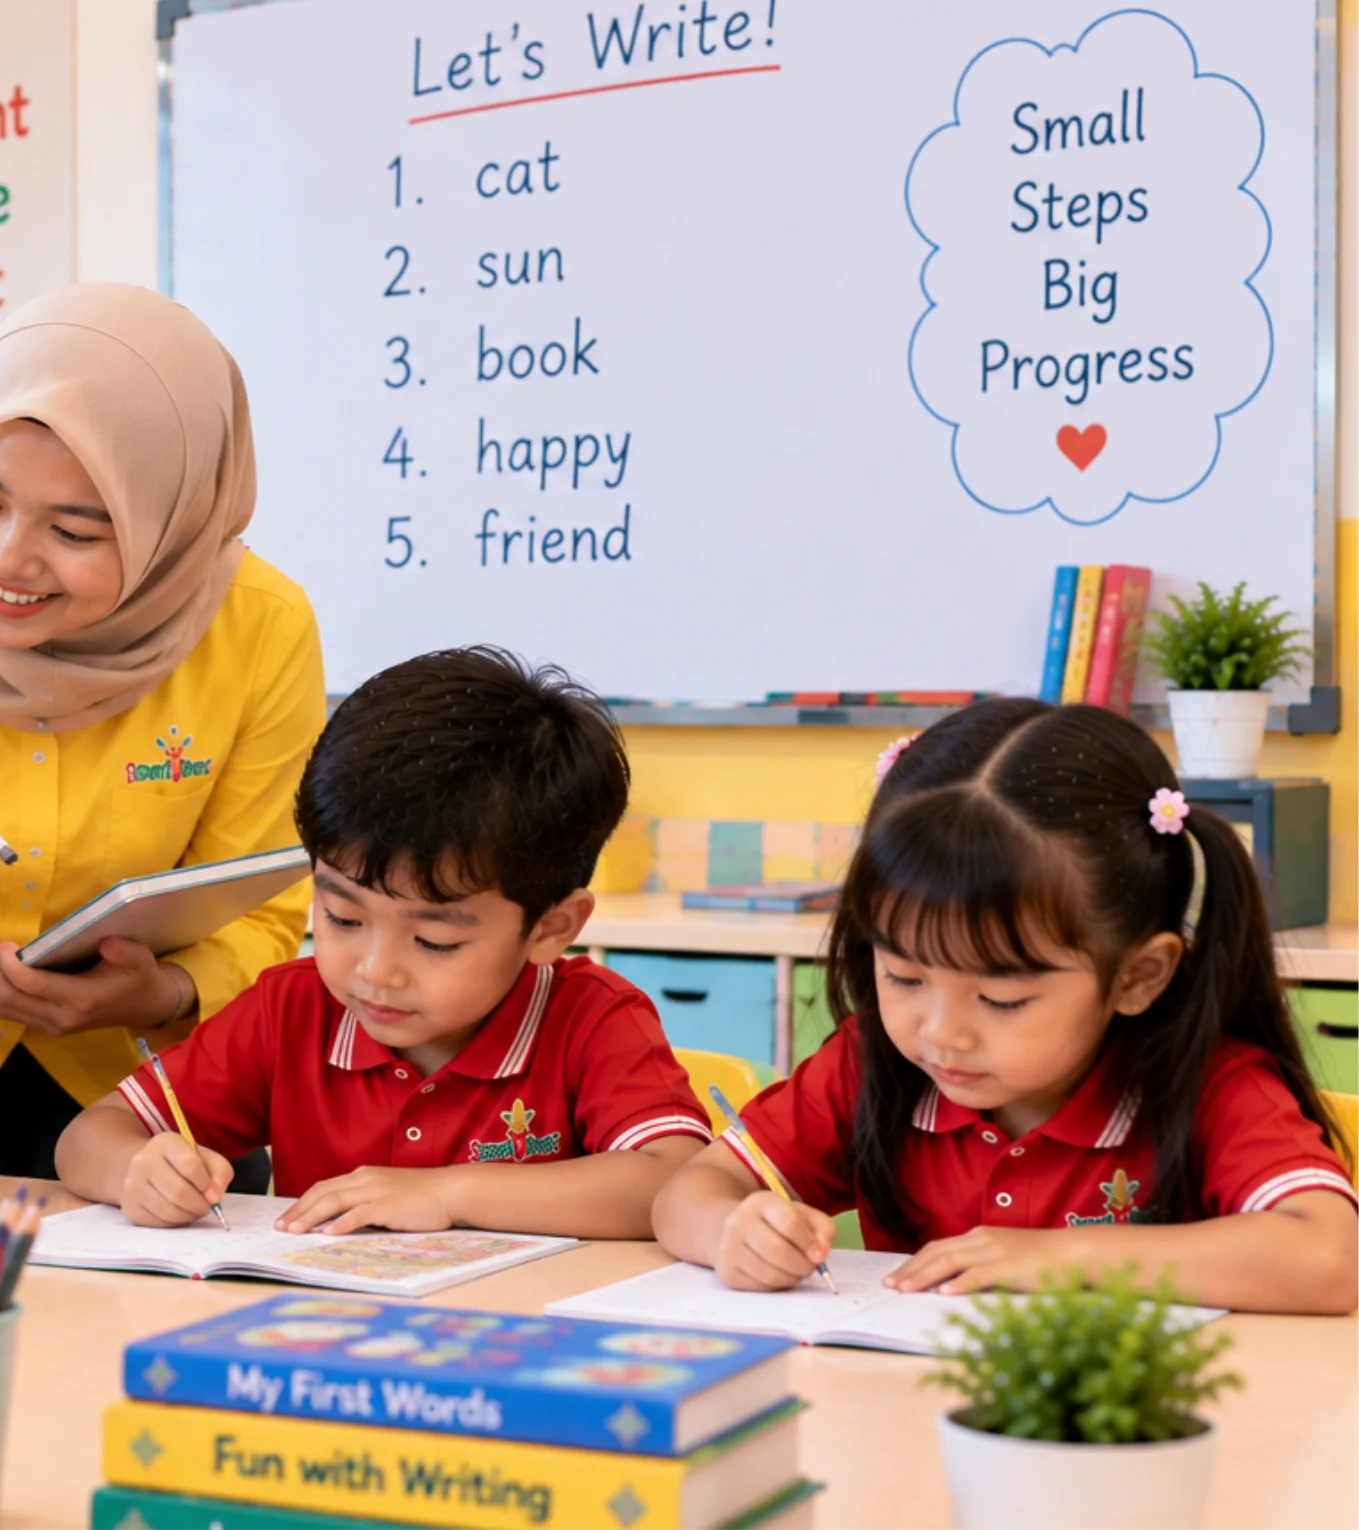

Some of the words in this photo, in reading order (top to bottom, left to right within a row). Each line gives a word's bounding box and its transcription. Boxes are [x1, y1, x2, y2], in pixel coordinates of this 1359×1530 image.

[413, 23, 545, 96] Let's
[587, 0, 777, 70] Write!
[1010, 86, 1145, 155] Small
[387, 154, 424, 208] 1.
[475, 140, 560, 199] cat
[1010, 180, 1149, 245] Steps
[383, 245, 426, 298] 2.
[476, 247, 564, 289] sun
[1043, 258, 1118, 325] Big
[383, 335, 427, 390] 3.
[476, 316, 600, 382] book
[980, 338, 1194, 406] Progress
[382, 427, 427, 479] 4.
[477, 417, 632, 492] happy
[384, 515, 427, 569] 5.
[475, 503, 632, 567] friend
[227, 1361, 283, 1412] My
[292, 1368, 374, 1416] First
[381, 1377, 503, 1431] Words
[214, 1434, 285, 1480] Fun
[297, 1451, 386, 1494] with
[399, 1458, 552, 1524] Writing
